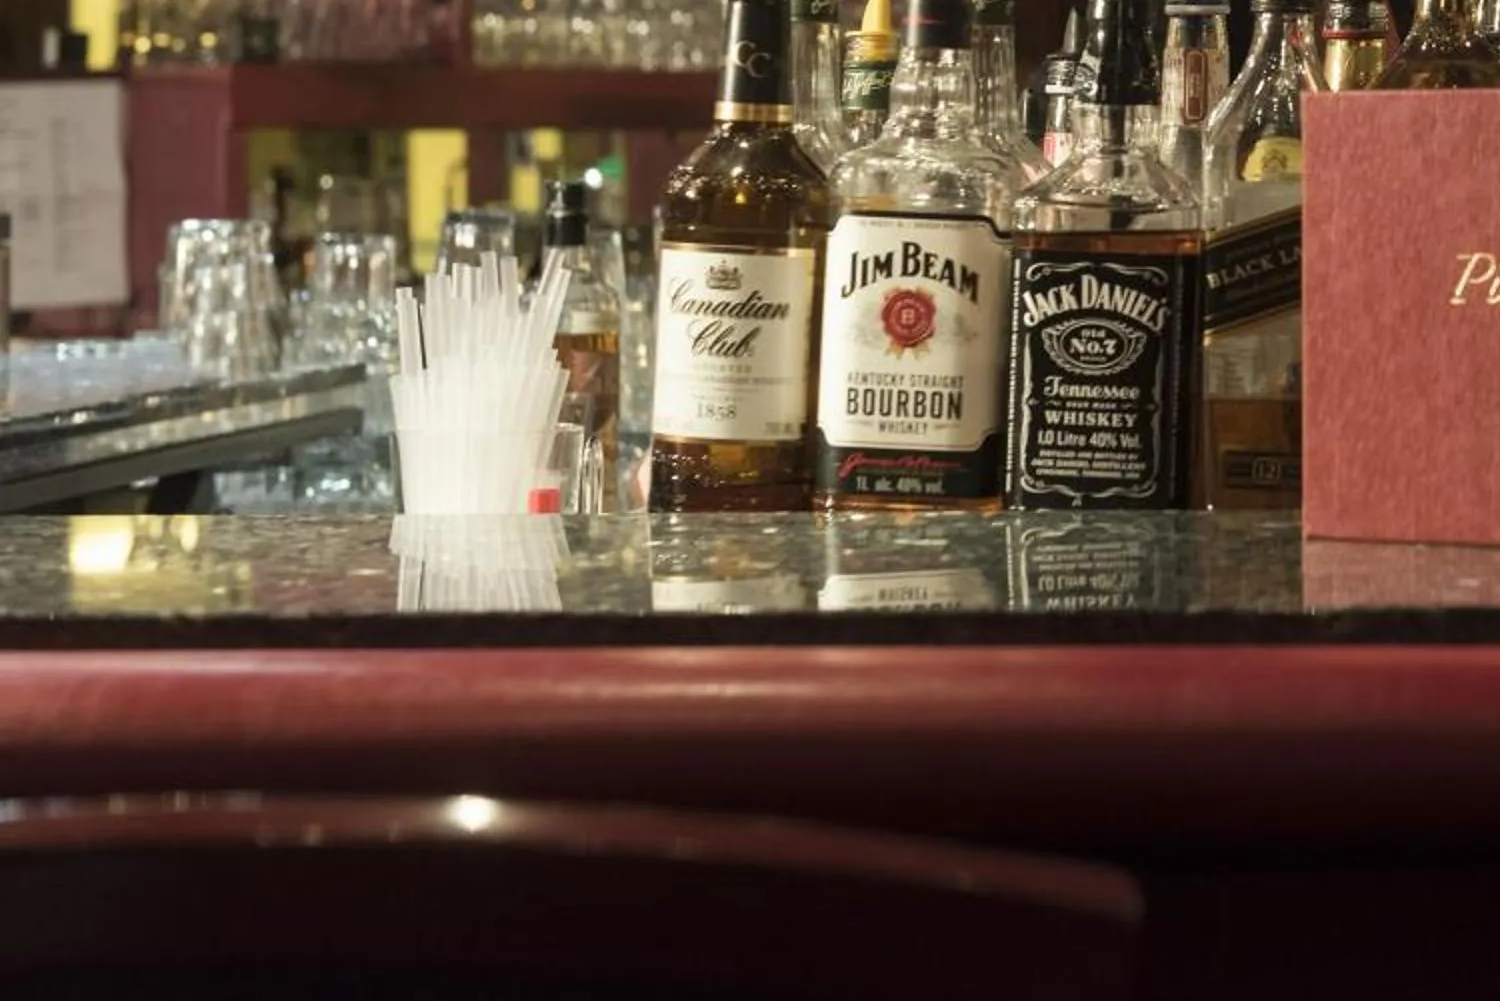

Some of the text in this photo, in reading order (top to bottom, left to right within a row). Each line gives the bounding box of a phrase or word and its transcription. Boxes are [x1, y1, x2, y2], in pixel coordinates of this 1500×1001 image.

[841, 241, 981, 304] JIM BEAM
[1206, 254, 1276, 289] BLACK
[669, 276, 791, 321] Canadian
[1022, 274, 1171, 333] JACK DANIEL'S
[687, 319, 762, 360] Club
[846, 387, 964, 421] BOURBON
[1043, 375, 1141, 400] Tennessee
[696, 402, 738, 421] 1858
[878, 420, 929, 435] WHISKEY
[1043, 410, 1138, 428] WHISKEY
